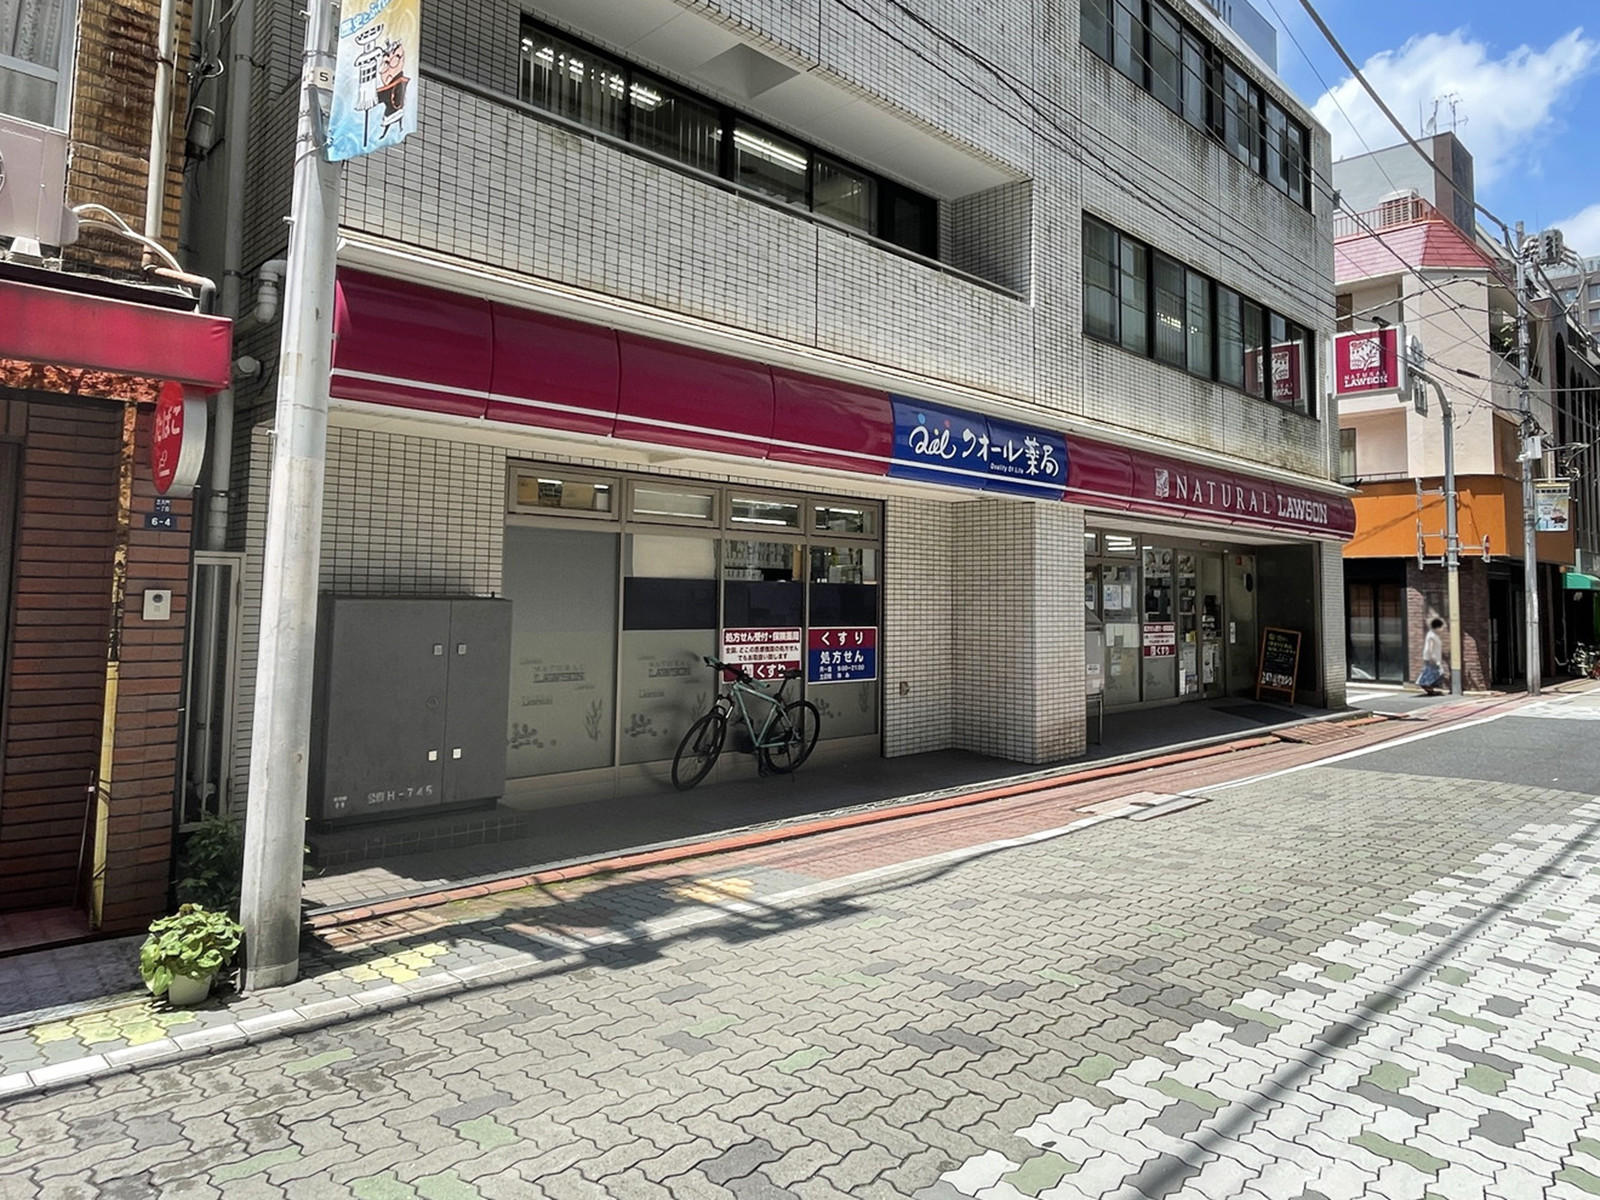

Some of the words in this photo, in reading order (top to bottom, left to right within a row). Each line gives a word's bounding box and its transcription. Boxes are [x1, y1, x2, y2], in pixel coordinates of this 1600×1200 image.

[1344, 375, 1388, 388] LAWSON
[154, 405, 182, 442] たばこ
[962, 428, 1059, 477] クオール薬局
[1176, 474, 1271, 515] NATURAL
[1277, 494, 1328, 524] LAWSON
[151, 517, 171, 526] 6-4
[821, 631, 864, 646] くすり
[820, 650, 864, 665] 処方せん
